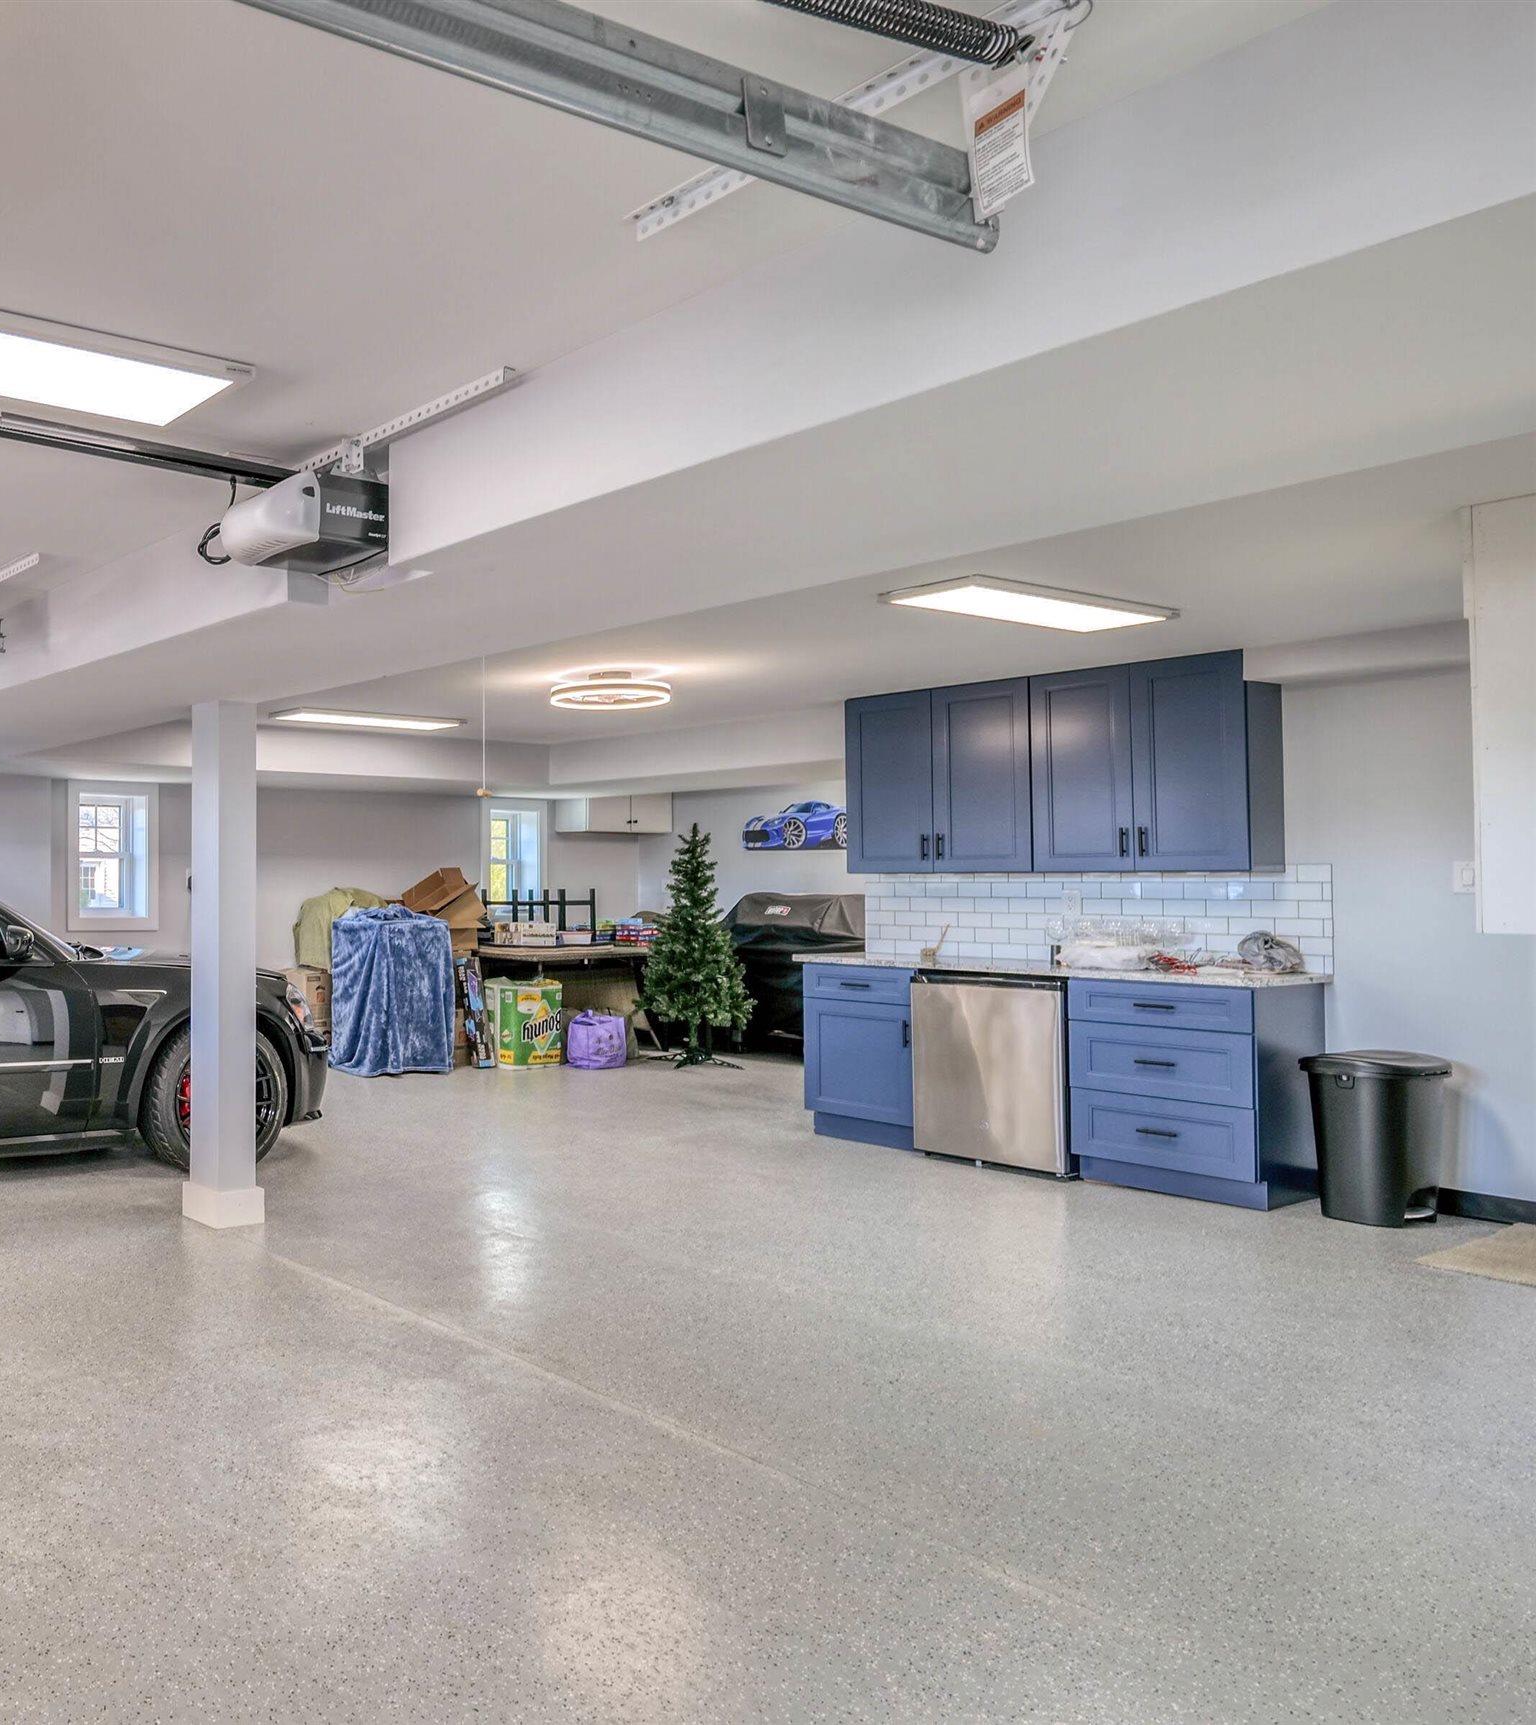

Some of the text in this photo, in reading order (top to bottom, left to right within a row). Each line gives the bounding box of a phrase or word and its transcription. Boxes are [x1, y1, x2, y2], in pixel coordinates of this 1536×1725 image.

[987, 97, 1022, 124] WARNING
[326, 502, 385, 521] LiftMaster
[522, 1008, 562, 1042] Bounty
